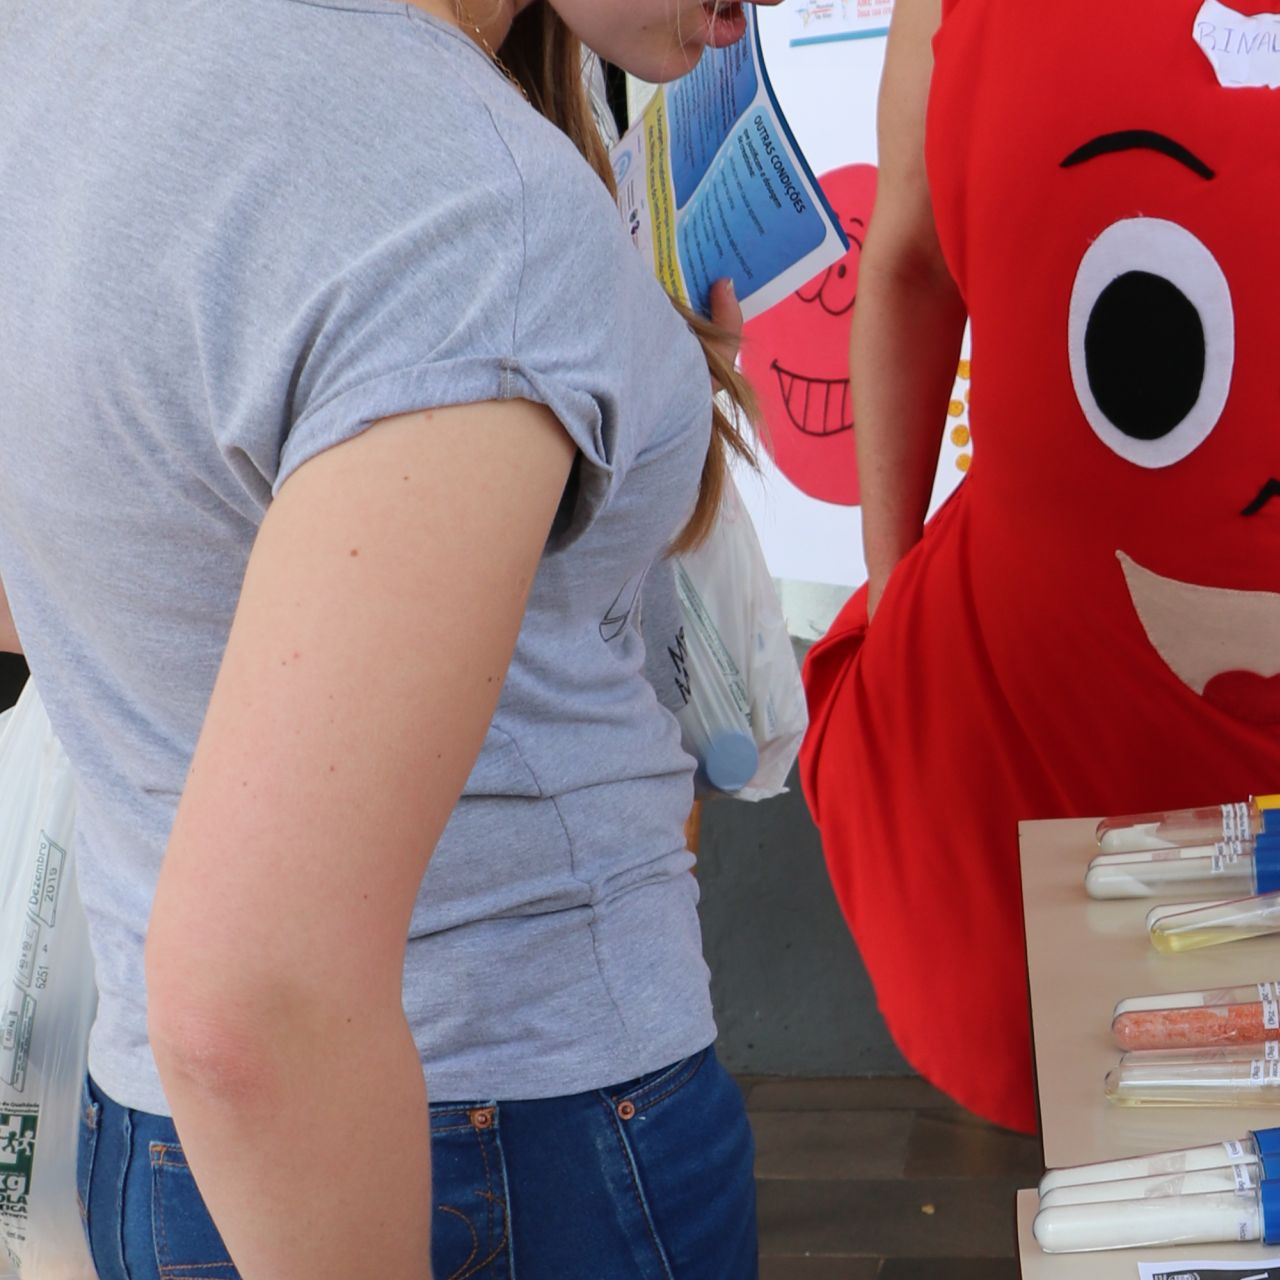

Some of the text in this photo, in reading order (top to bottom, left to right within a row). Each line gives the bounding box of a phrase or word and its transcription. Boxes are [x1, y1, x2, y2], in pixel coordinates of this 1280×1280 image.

[754, 115, 807, 215] OUTRAS CONDIÇÕES
[28, 841, 47, 906] Dezembro
[36, 964, 49, 990] 5251
